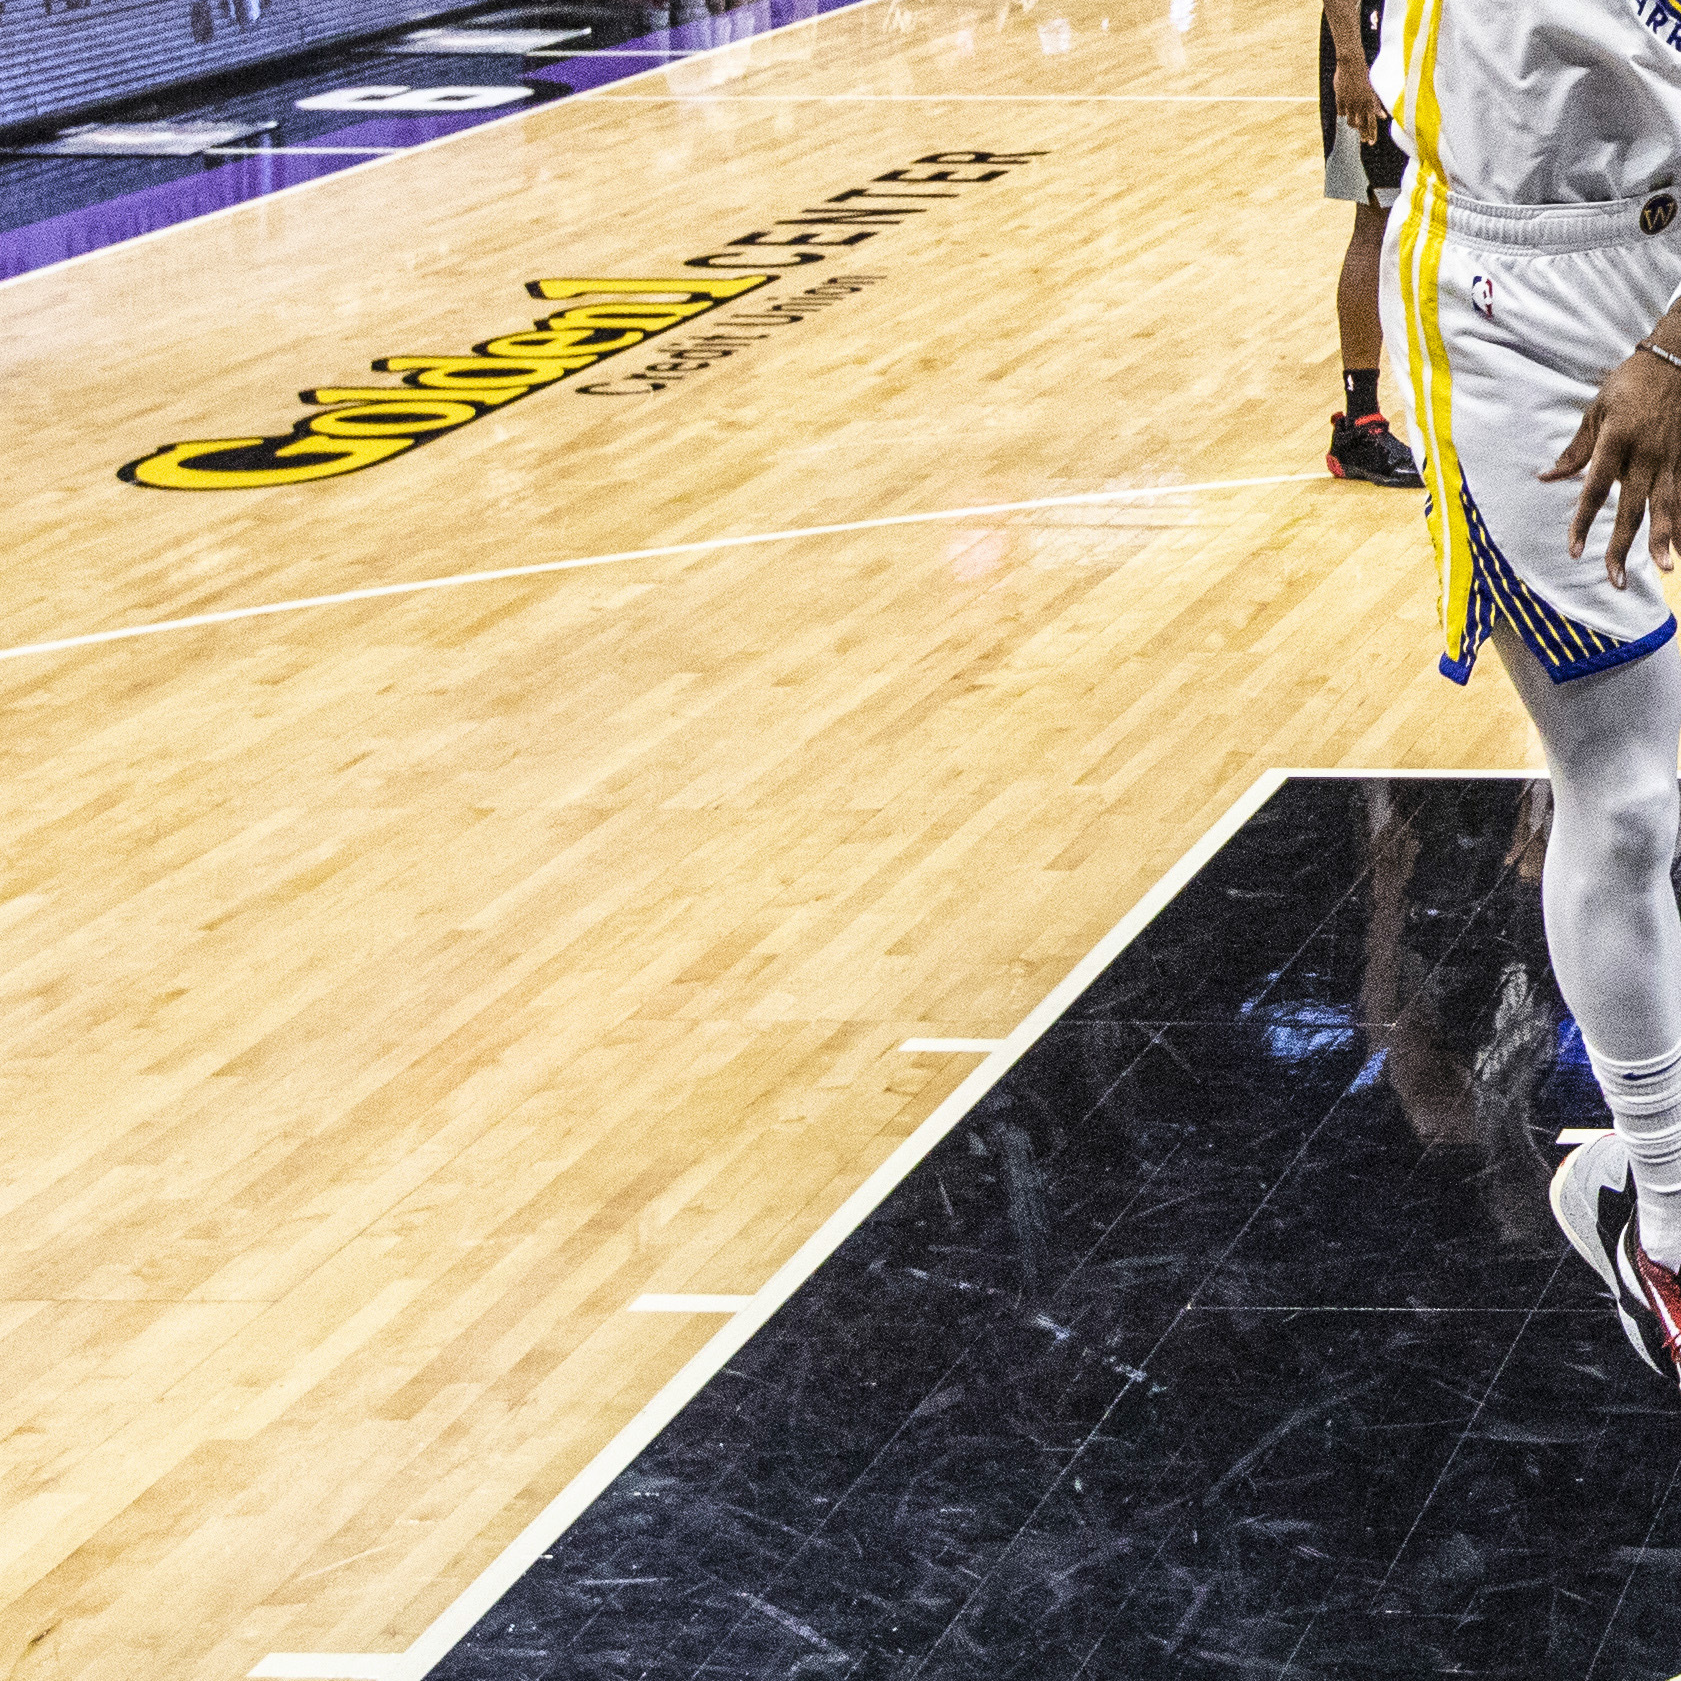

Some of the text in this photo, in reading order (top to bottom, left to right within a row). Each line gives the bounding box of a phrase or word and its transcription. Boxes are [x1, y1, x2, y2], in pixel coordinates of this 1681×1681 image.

[684, 148, 1052, 271] CENTER
[575, 272, 888, 397] Credit Union
